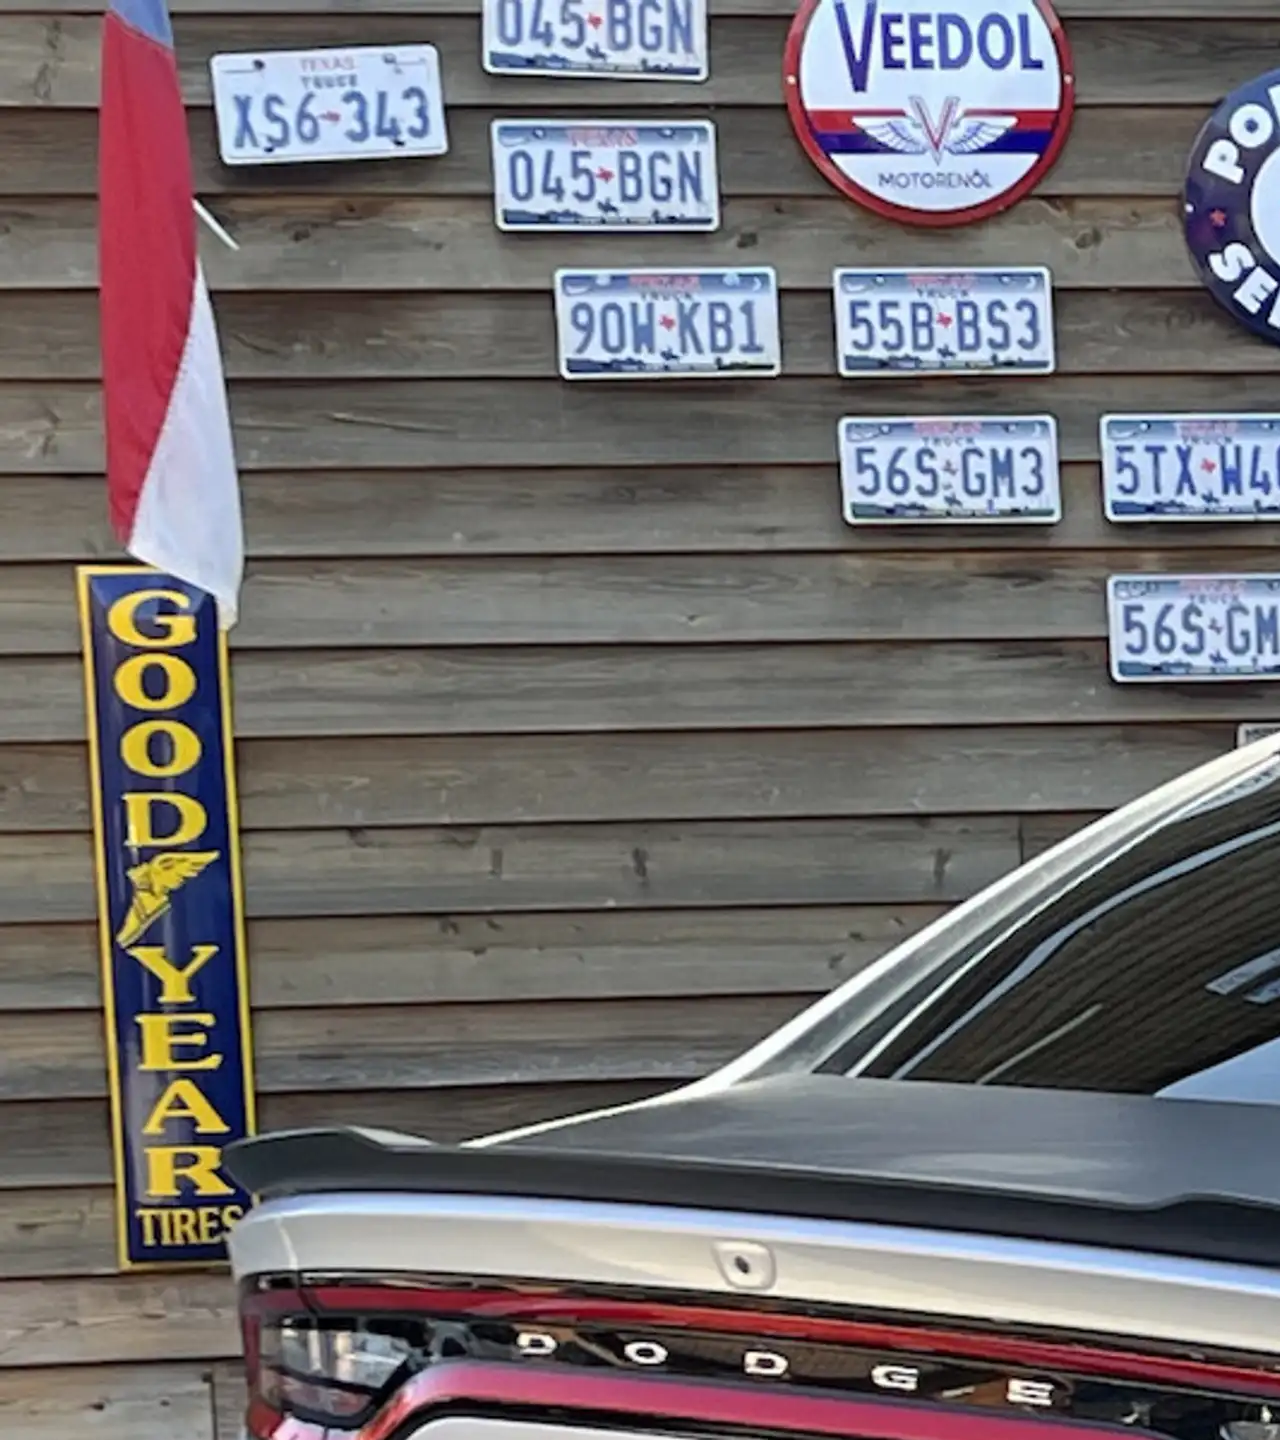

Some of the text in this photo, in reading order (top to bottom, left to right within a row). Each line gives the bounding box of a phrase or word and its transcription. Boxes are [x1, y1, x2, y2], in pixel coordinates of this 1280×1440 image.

[835, 0, 1044, 92] VEEDOL
[341, 86, 430, 143] 343
[618, 150, 703, 204] BGN
[849, 299, 1041, 352] 55B BS3
[961, 447, 1045, 498] GM3
[1115, 445, 1198, 496] 5TX
[517, 1331, 1054, 1407] DODGE
